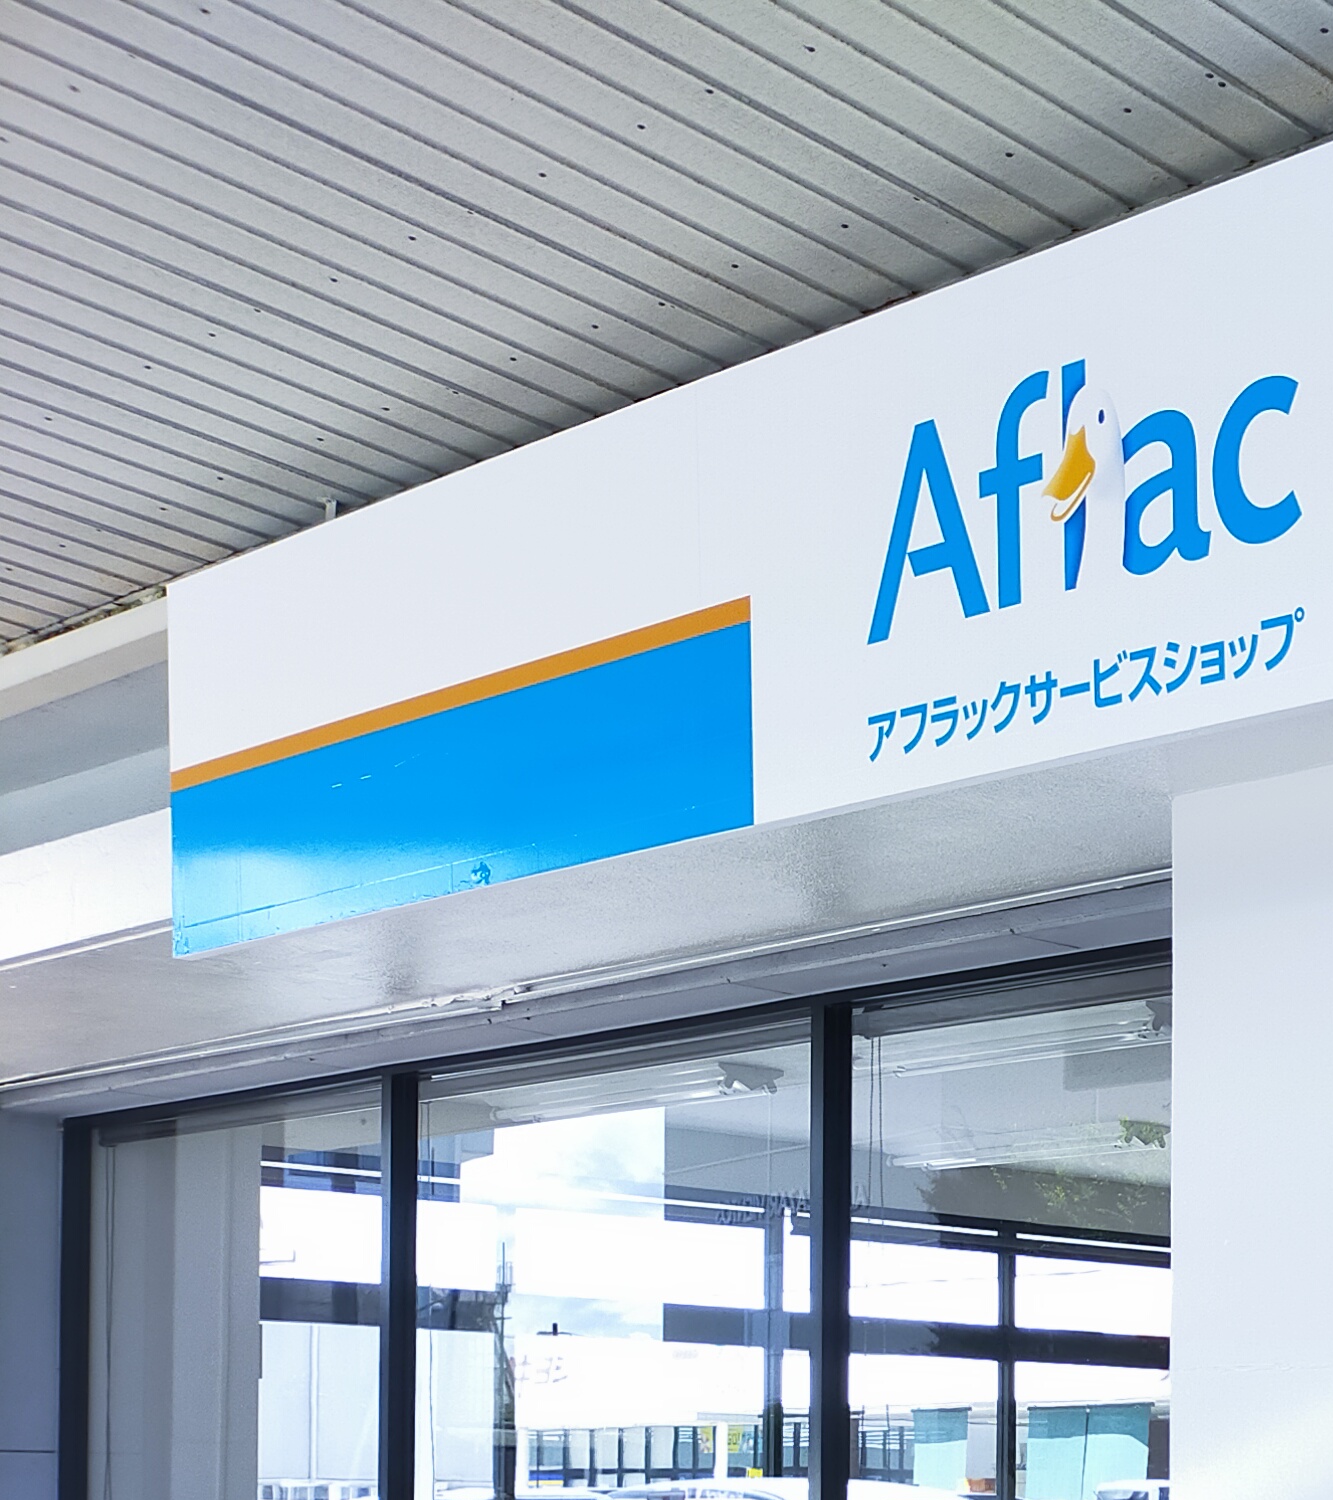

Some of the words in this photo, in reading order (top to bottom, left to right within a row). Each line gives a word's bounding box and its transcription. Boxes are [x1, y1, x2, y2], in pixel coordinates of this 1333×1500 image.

[867, 357, 1302, 646] Aflac
[866, 605, 1306, 762] アフラックサービスショップ
